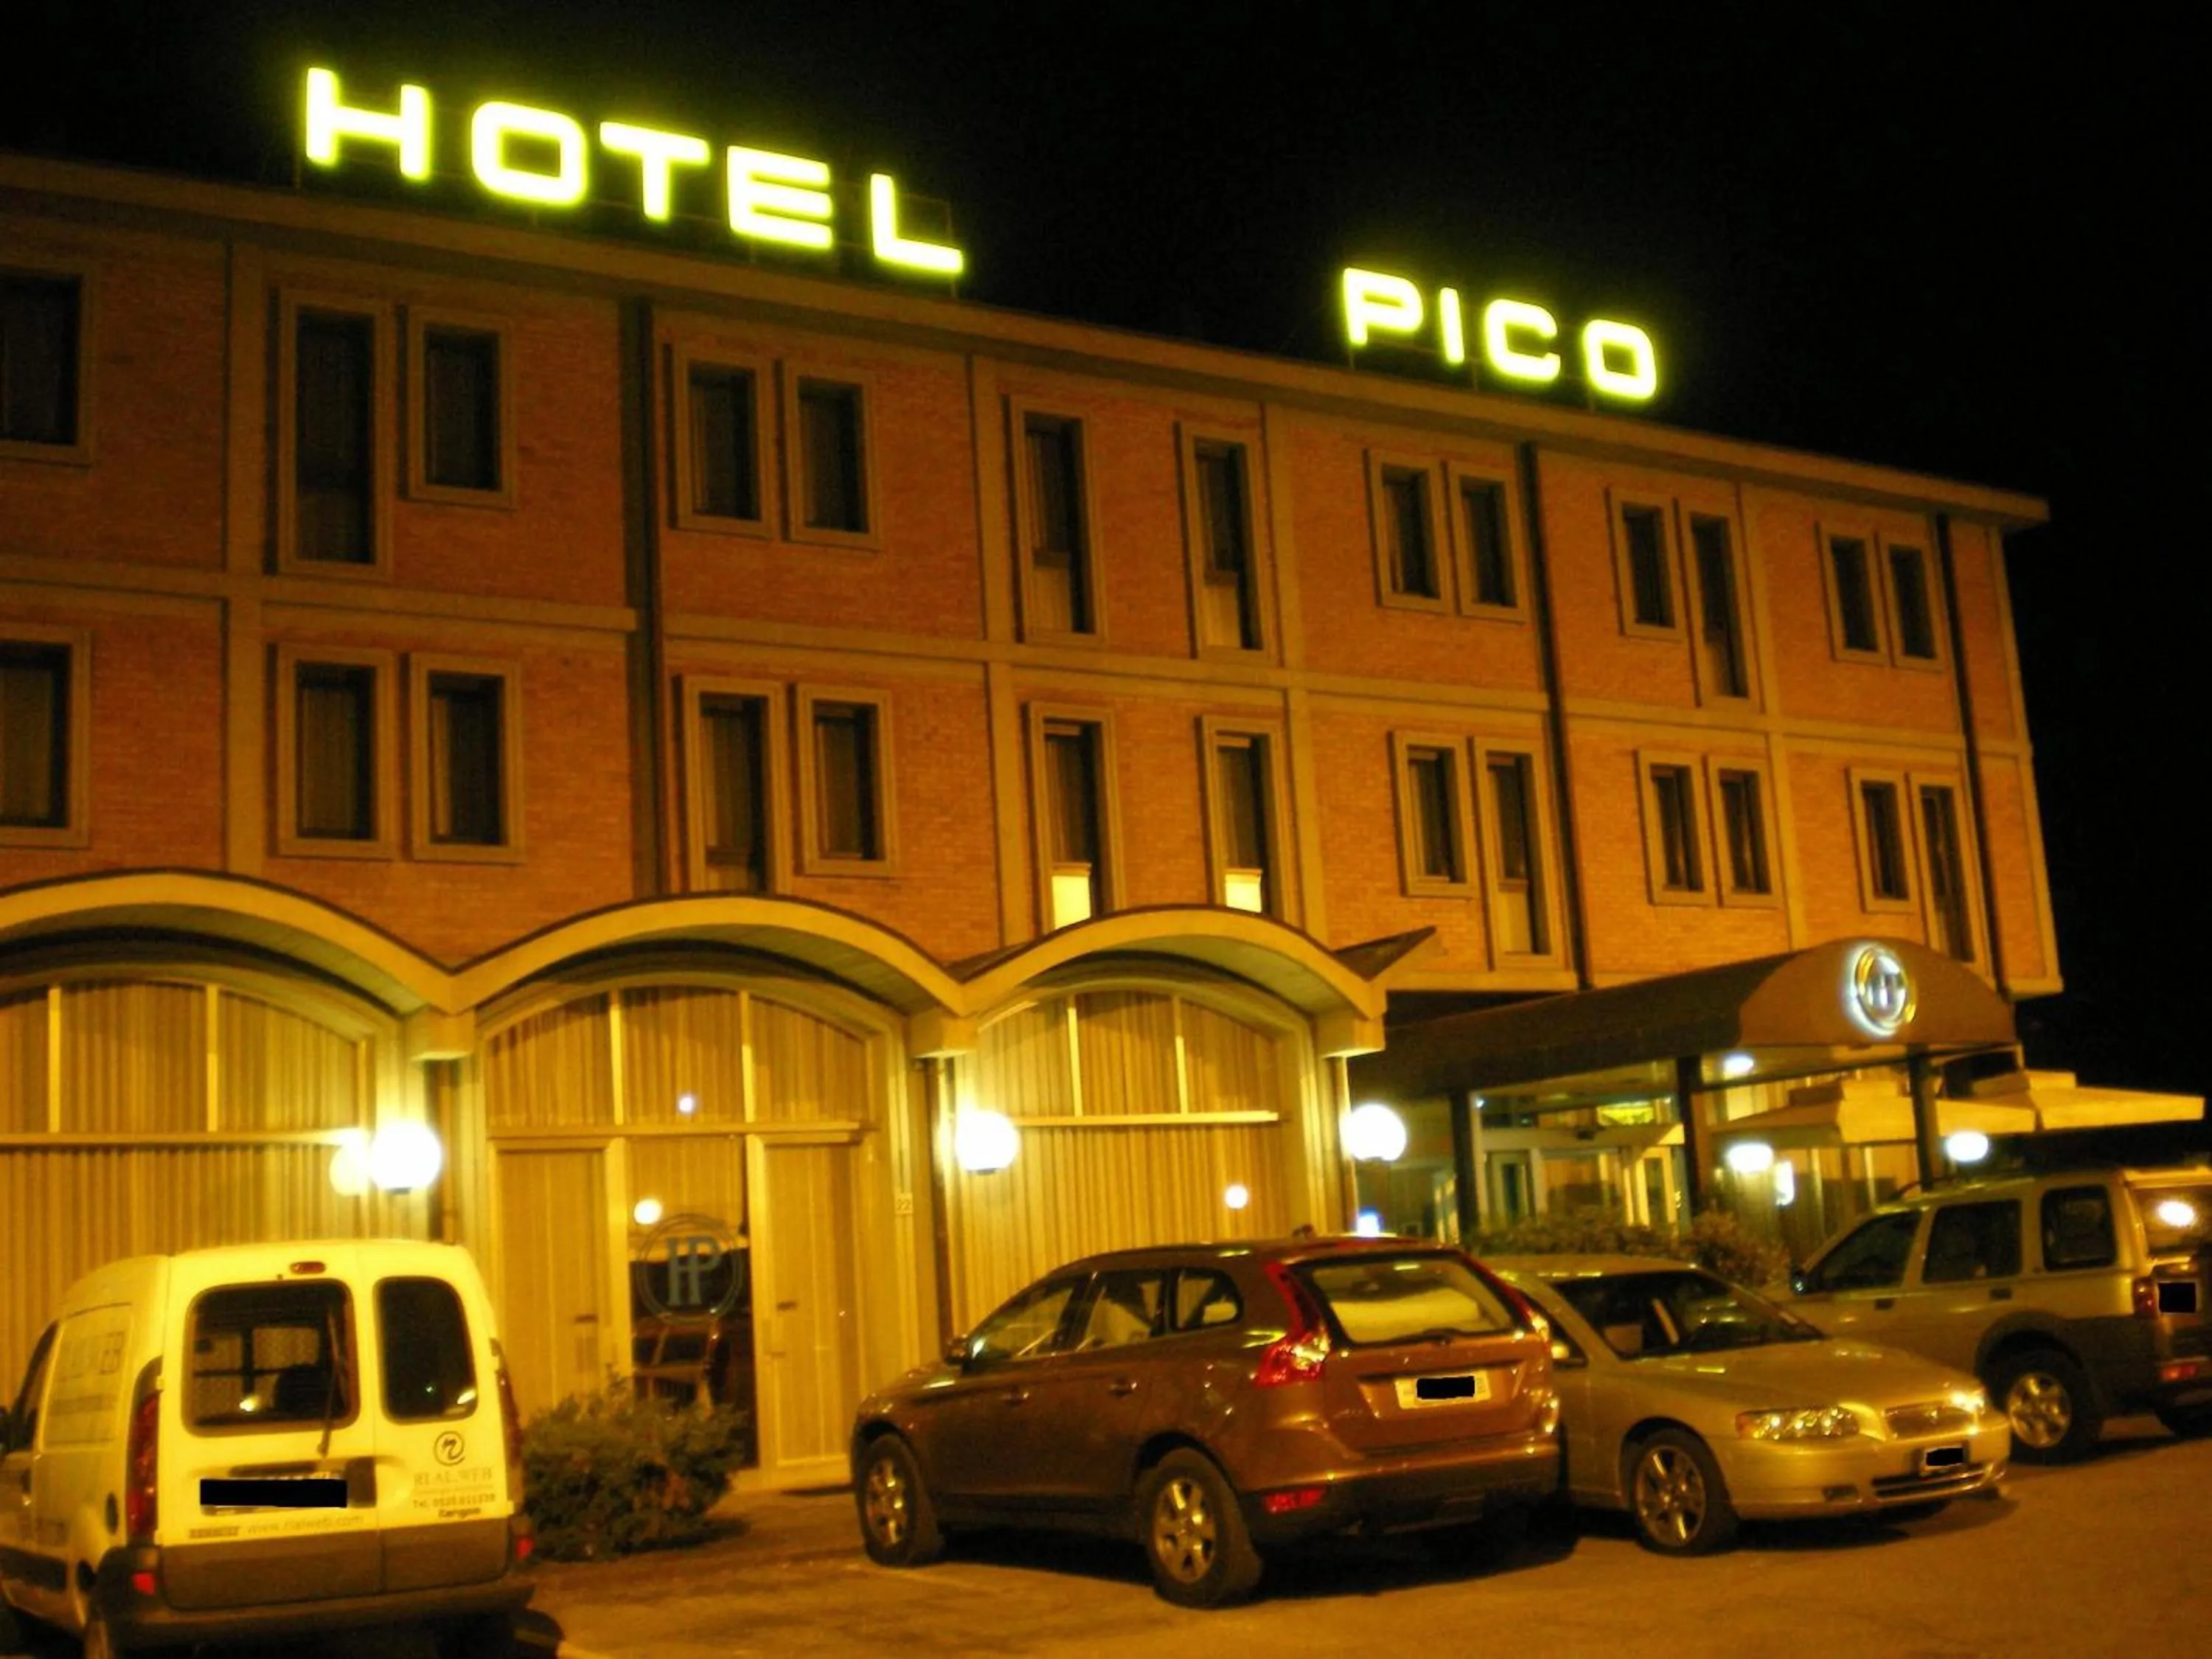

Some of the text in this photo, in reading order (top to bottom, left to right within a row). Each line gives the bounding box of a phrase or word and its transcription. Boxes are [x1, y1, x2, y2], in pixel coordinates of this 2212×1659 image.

[305, 66, 1659, 400] HOTEL PICO
[896, 1198, 911, 1211] 22
